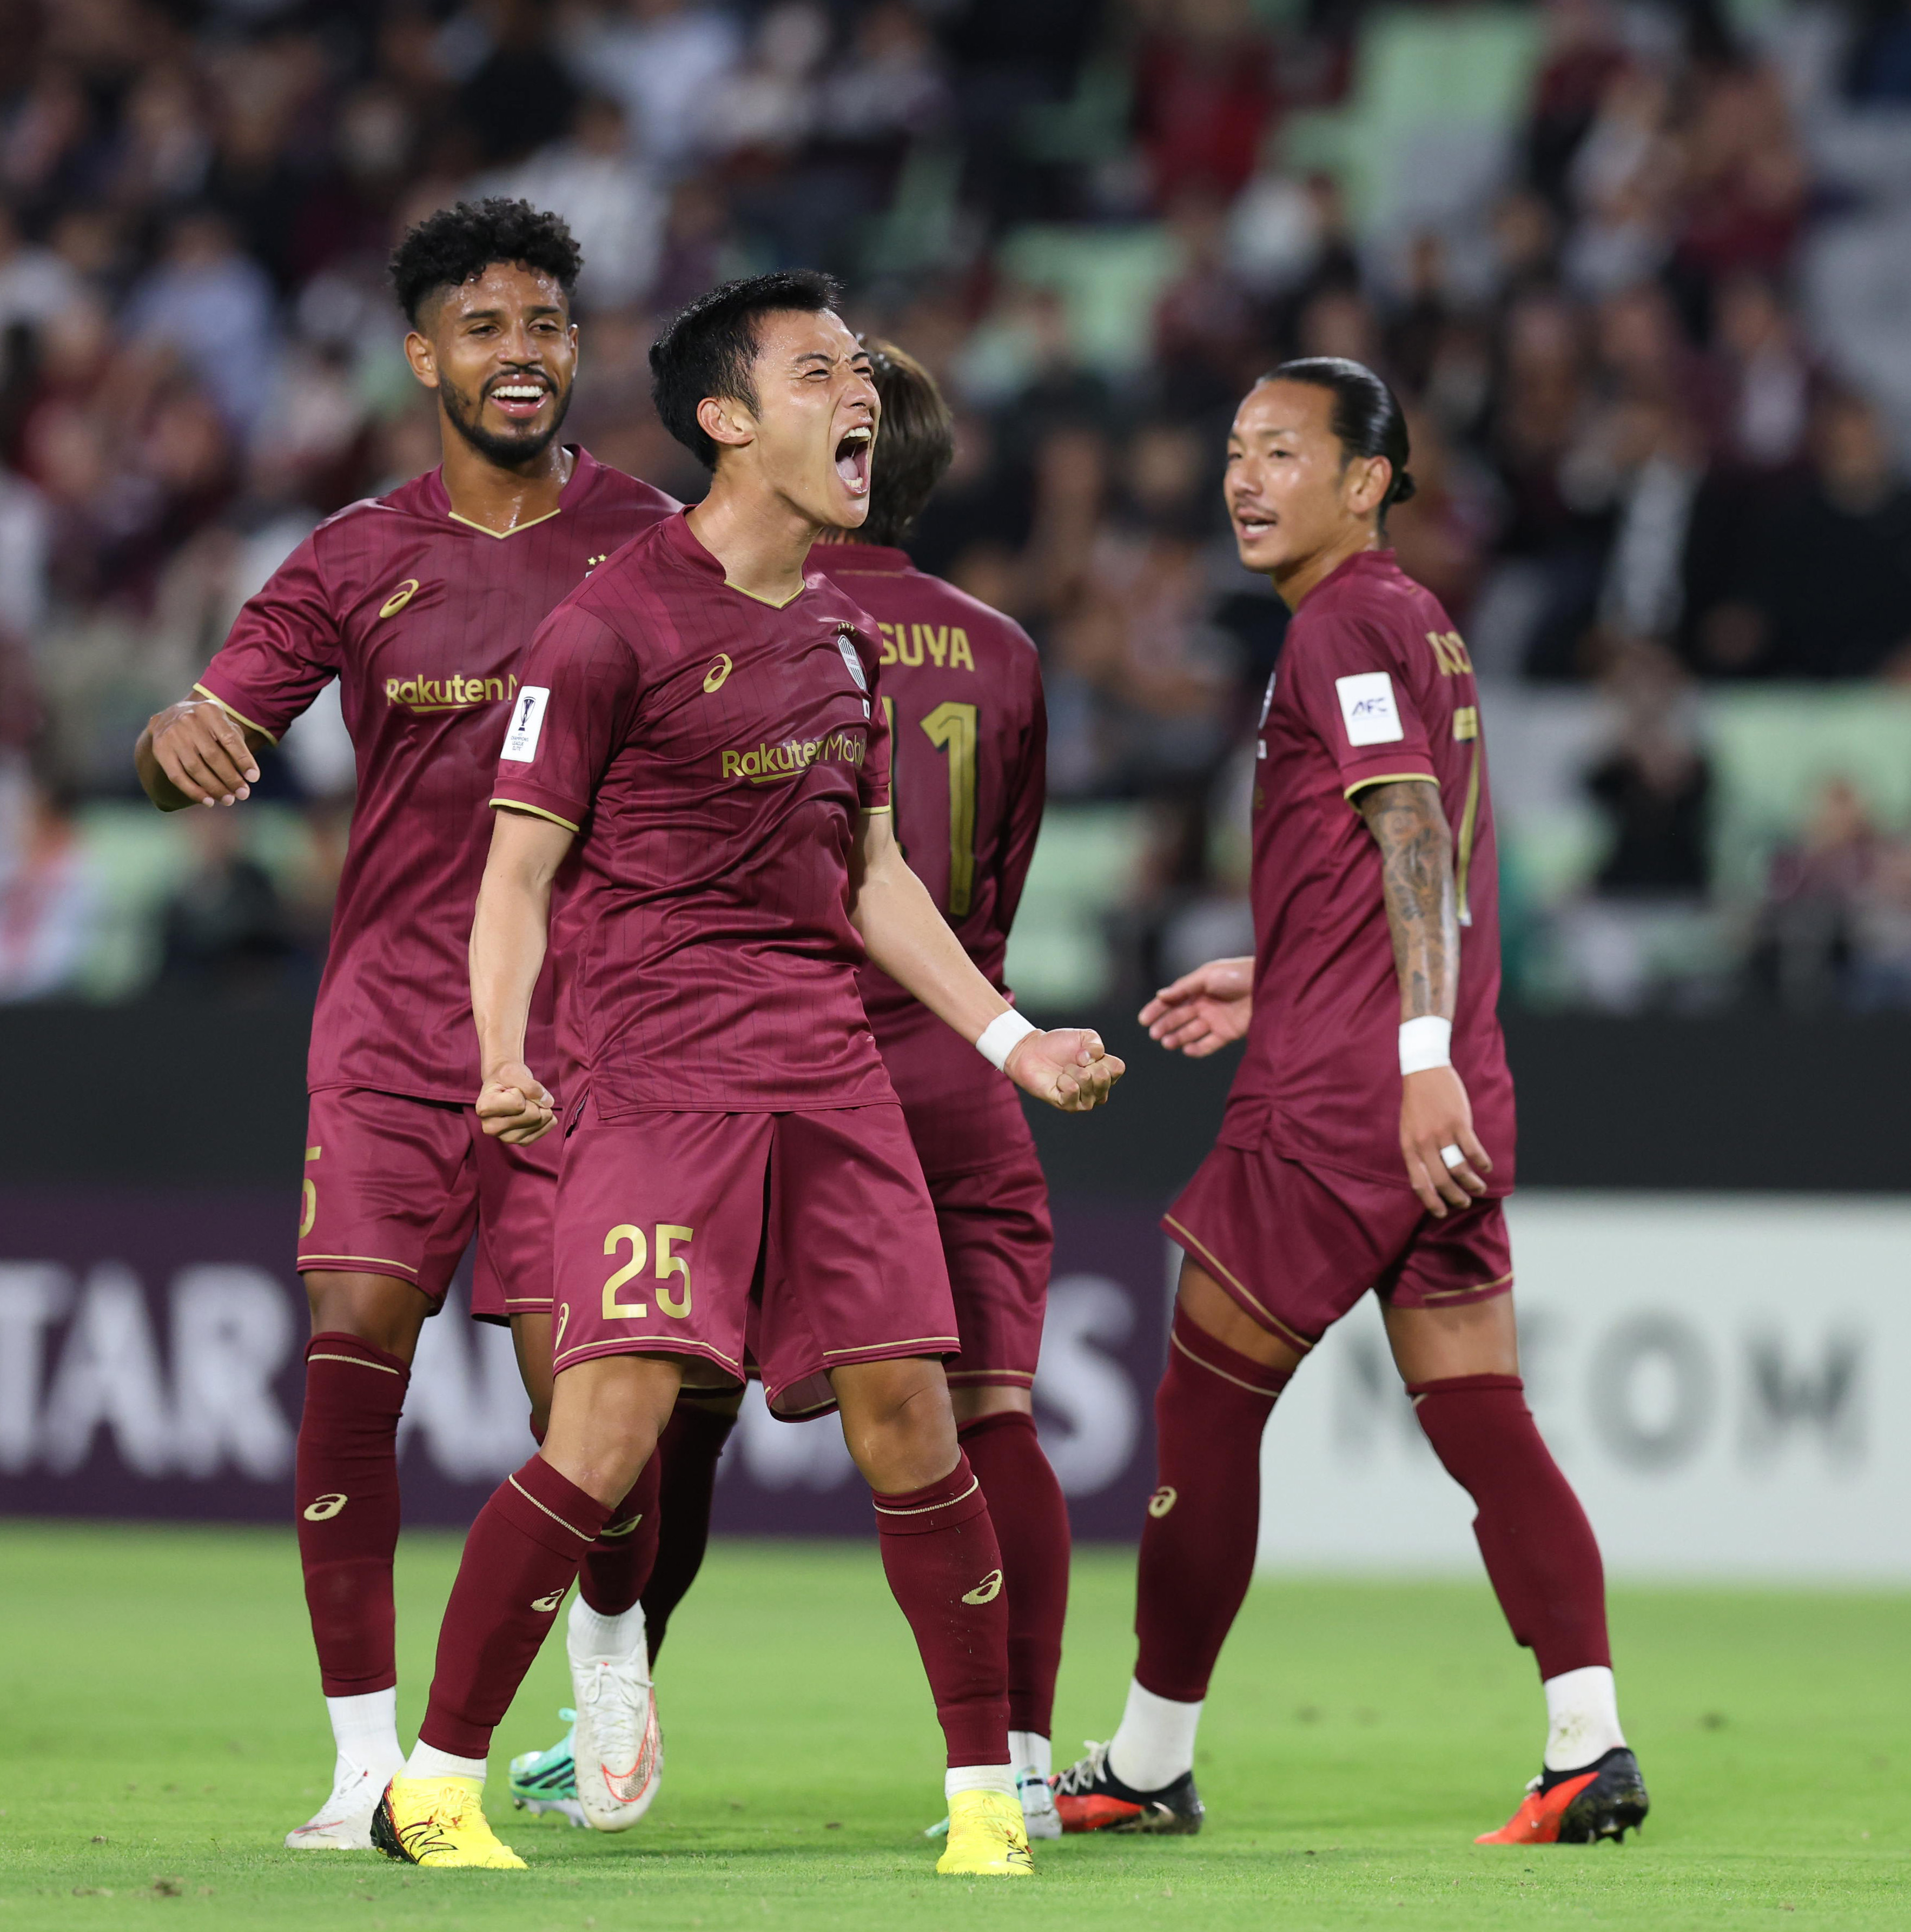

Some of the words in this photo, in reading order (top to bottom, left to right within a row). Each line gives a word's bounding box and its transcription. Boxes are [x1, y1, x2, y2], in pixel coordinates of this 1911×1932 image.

[880, 622, 975, 672] SUYA
[386, 674, 503, 706] Rakuten
[1352, 697, 1387, 716] AFC
[881, 696, 977, 917] 1
[601, 1223, 694, 1320] 25
